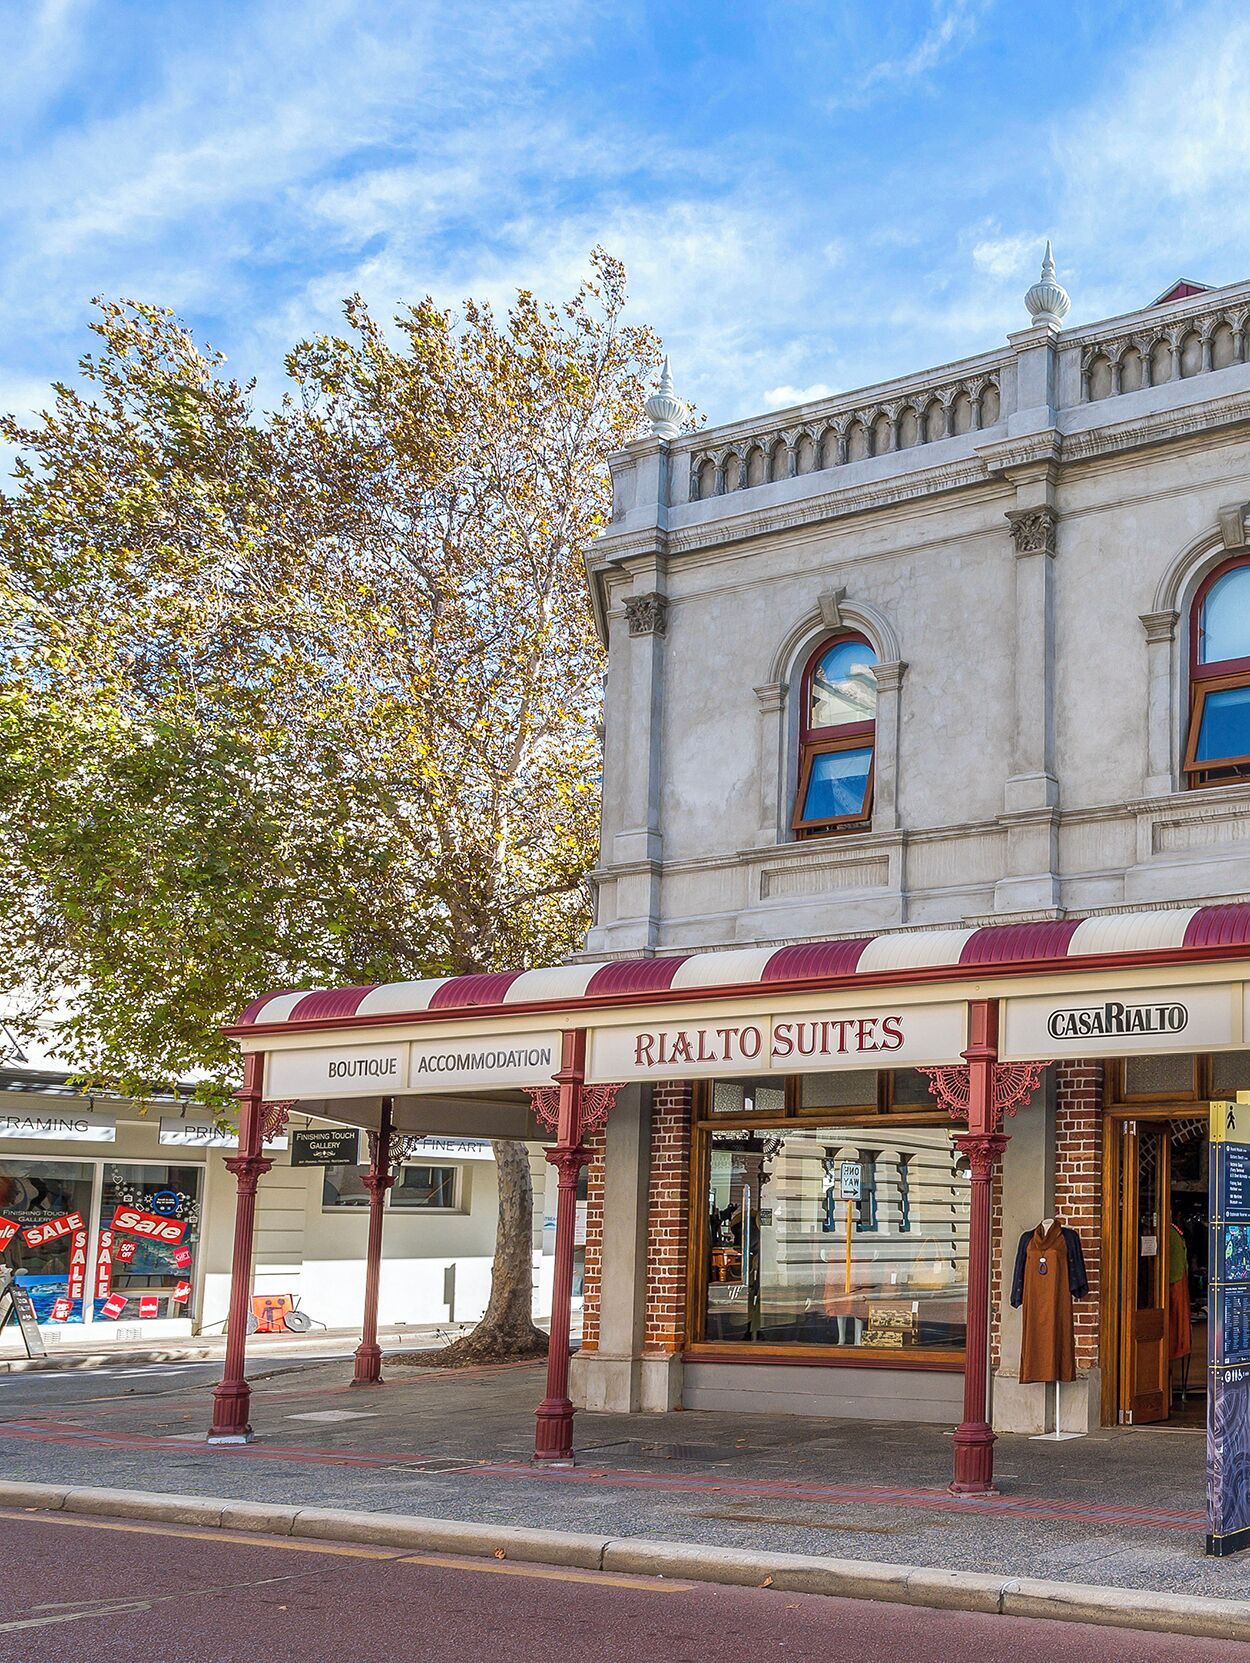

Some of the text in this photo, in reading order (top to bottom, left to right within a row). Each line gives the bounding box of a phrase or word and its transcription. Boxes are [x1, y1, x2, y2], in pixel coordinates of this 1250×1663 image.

[634, 1015, 905, 1068] RIALTO SUITES
[328, 1048, 551, 1078] BOUTIQUE ACCOMMODATION
[296, 1131, 355, 1141] FINISHING TOUCH
[309, 1141, 341, 1149] GALLERY
[423, 1139, 484, 1153] FINE ART
[43, 1209, 69, 1217] TOUCH
[115, 1212, 181, 1239] Sale
[26, 1214, 84, 1244] SALE
[71, 1231, 87, 1299] SALE
[98, 1231, 113, 1298] SALE
